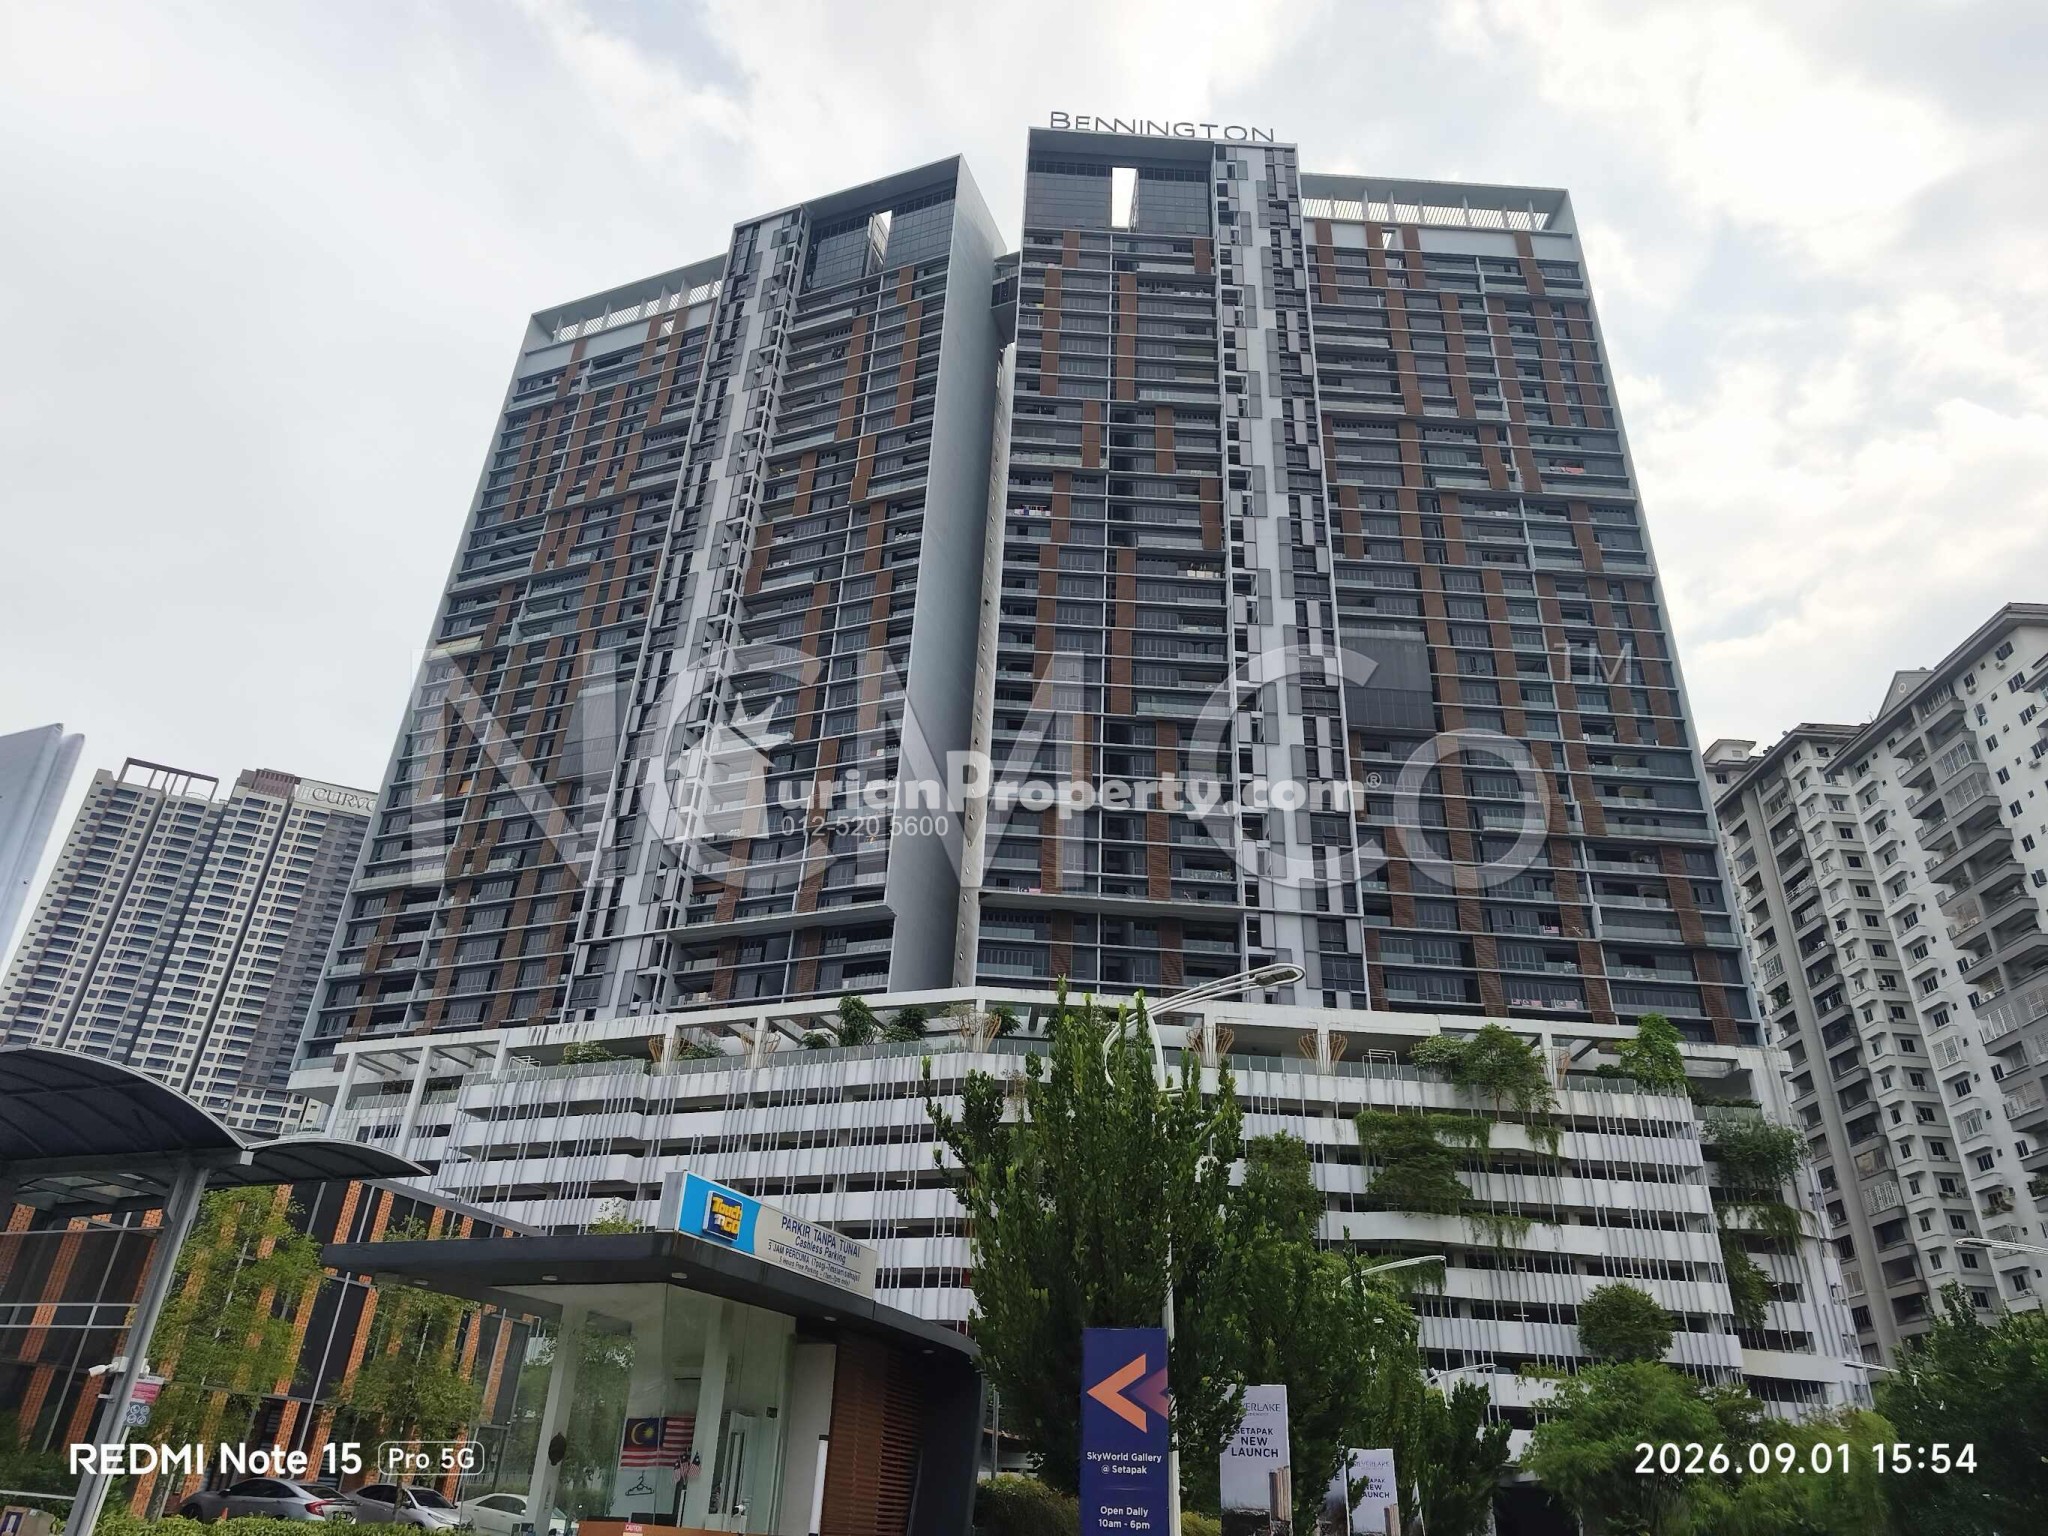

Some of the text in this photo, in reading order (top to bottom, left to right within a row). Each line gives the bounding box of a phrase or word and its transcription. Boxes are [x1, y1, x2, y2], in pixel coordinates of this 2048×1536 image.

[1050, 111, 1274, 142] BENNINGTON
[782, 1215, 860, 1258] PARKIR TANPA TUNAI
[773, 1242, 784, 1254] JAM
[785, 1248, 809, 1264] PERCUMA
[795, 1235, 846, 1266] Cashless Parking
[1241, 1436, 1268, 1446] NEW
[1086, 1451, 1162, 1463] SkyWorld Gallery
[1231, 1447, 1279, 1458] LAUNCH
[1101, 1464, 1147, 1475] @ Setapak
[1362, 1491, 1390, 1499] AUNCH
[1100, 1506, 1148, 1517] Open Daily
[1098, 1518, 1122, 1528] 10am
[1130, 1520, 1150, 1530] 6pm
